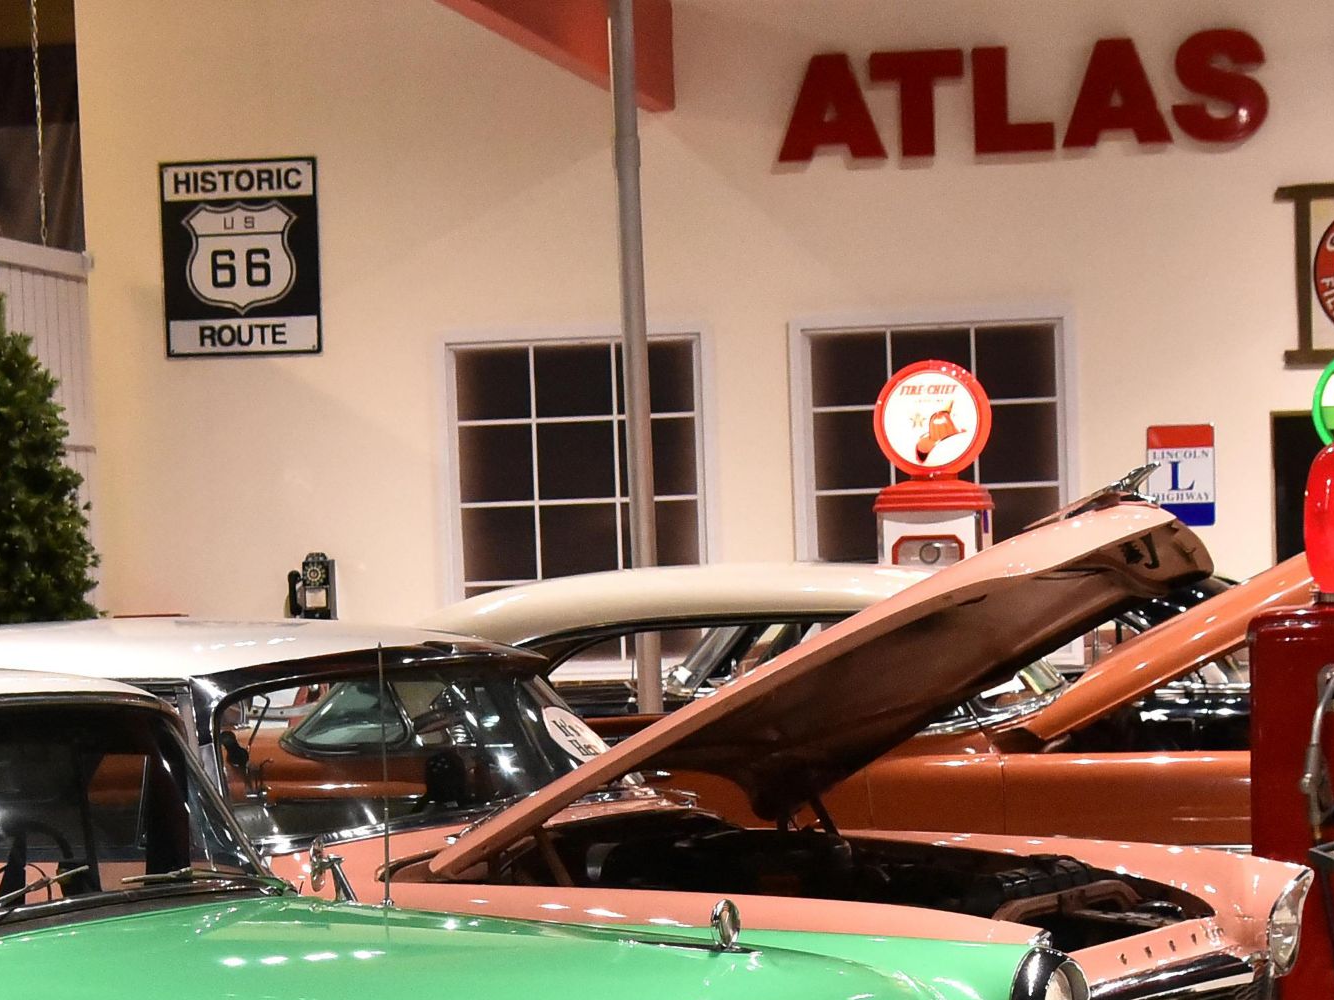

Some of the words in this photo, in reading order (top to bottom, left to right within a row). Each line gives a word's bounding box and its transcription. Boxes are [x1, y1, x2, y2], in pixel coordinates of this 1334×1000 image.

[777, 27, 1270, 163] ATLAS
[173, 168, 302, 194] HISTORIC
[211, 248, 271, 289] 66
[199, 324, 287, 347] ROUTE
[900, 385, 925, 396] FIRE
[927, 384, 959, 396] CHIEF
[1153, 450, 1210, 461] LINCOLN
[1168, 461, 1196, 491] L
[1151, 491, 1210, 502] HIGHWAY
